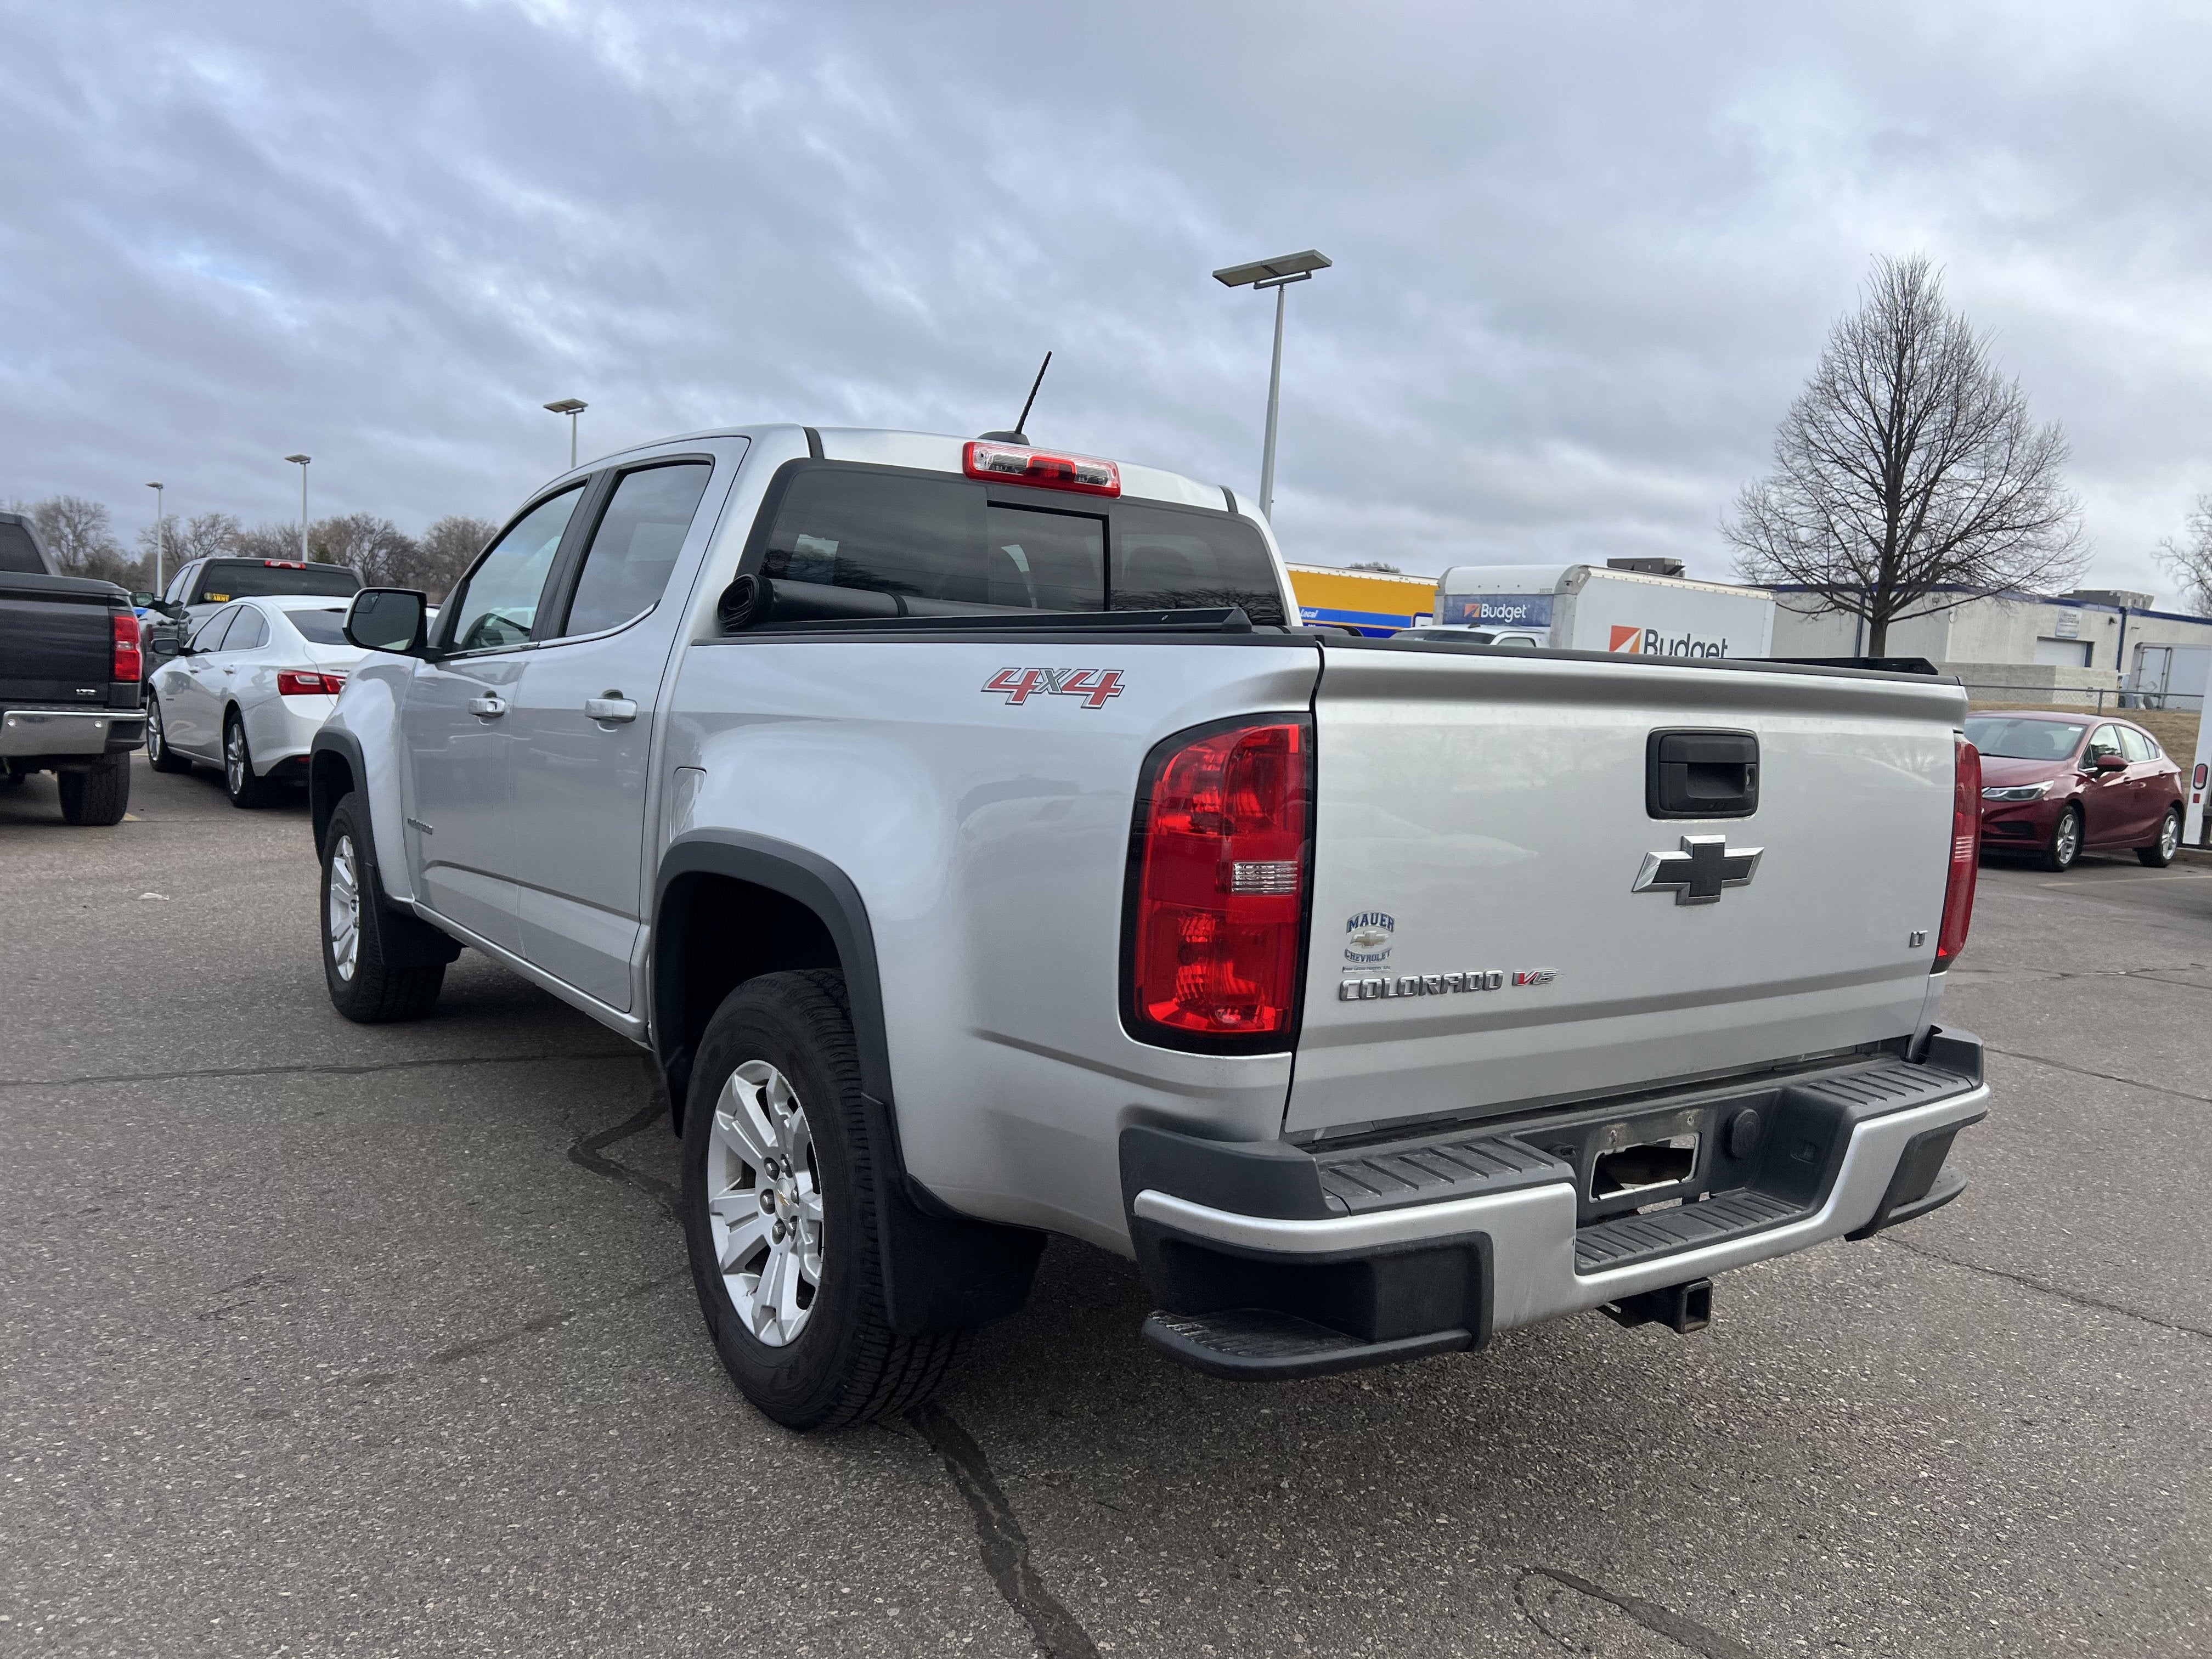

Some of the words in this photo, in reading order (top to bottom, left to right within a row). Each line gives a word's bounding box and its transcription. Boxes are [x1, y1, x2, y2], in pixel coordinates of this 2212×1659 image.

[1300, 608, 1319, 618] Local
[1481, 603, 1527, 623] Budget
[1347, 912, 1394, 933] MAUER
[1345, 947, 1392, 963] CHEVROLET
[1339, 970, 1503, 1001] COLORADO
[1512, 969, 1559, 986] V6
